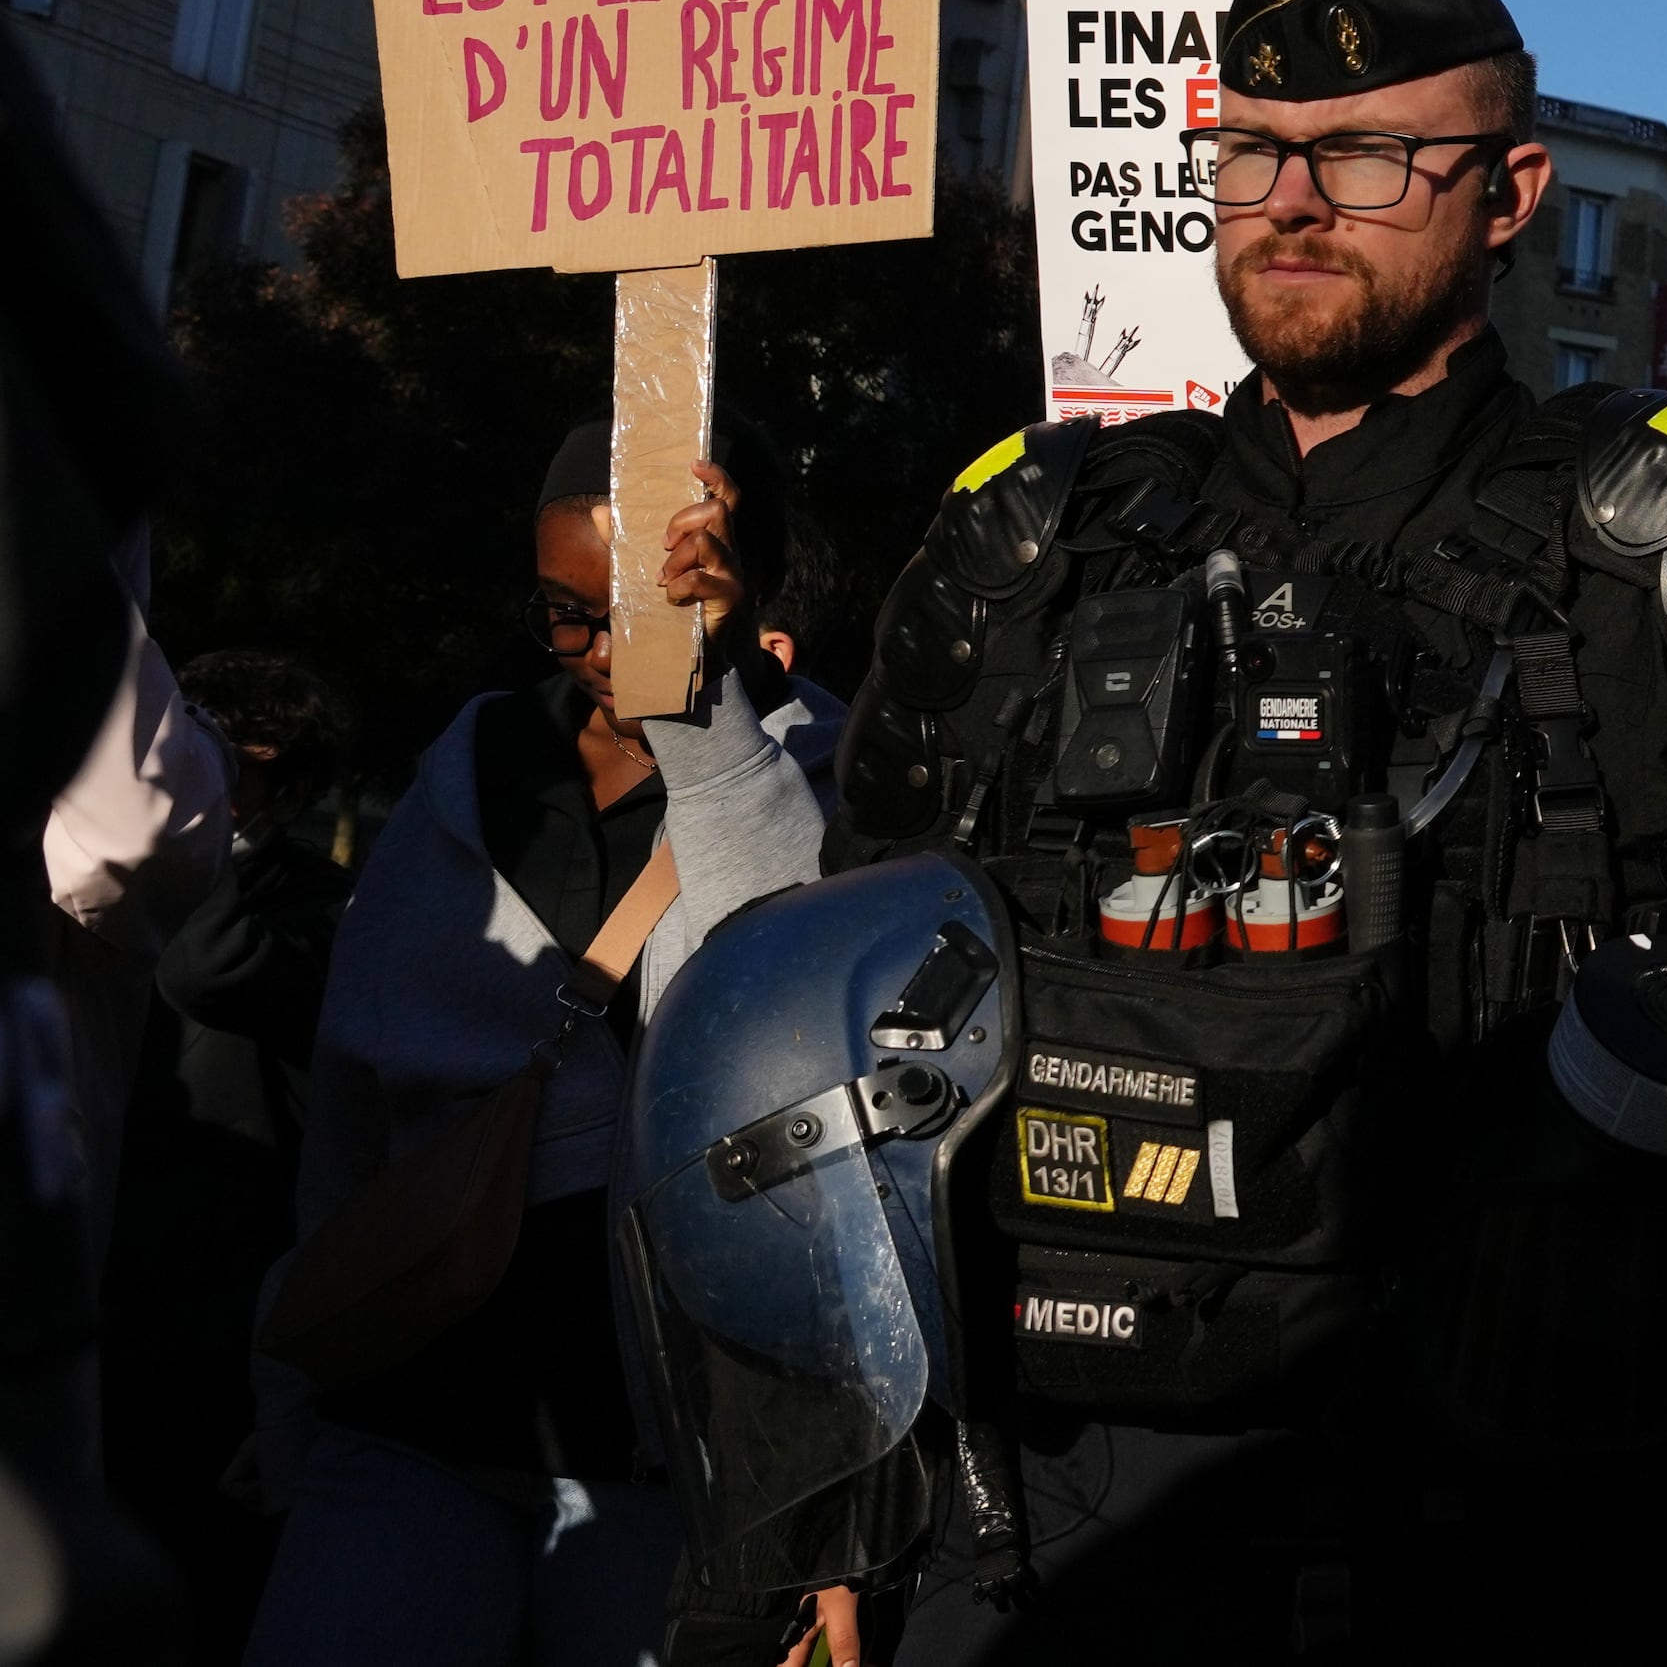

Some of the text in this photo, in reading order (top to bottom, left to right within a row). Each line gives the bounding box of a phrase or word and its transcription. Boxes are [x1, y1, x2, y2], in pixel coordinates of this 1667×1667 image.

[464, 8, 628, 123] D'UN
[1068, 77, 1166, 129] LES
[1071, 160, 1140, 198] PAS
[1257, 582, 1293, 612] A
[1260, 697, 1318, 718] GENDARMERIE
[1260, 719, 1318, 730] NATIONALE
[1028, 1053, 1197, 1107] GENDARMERIE
[1027, 1119, 1099, 1165] DHR
[1033, 1166, 1095, 1201] 13/1
[1024, 1296, 1136, 1340] MEDIC
